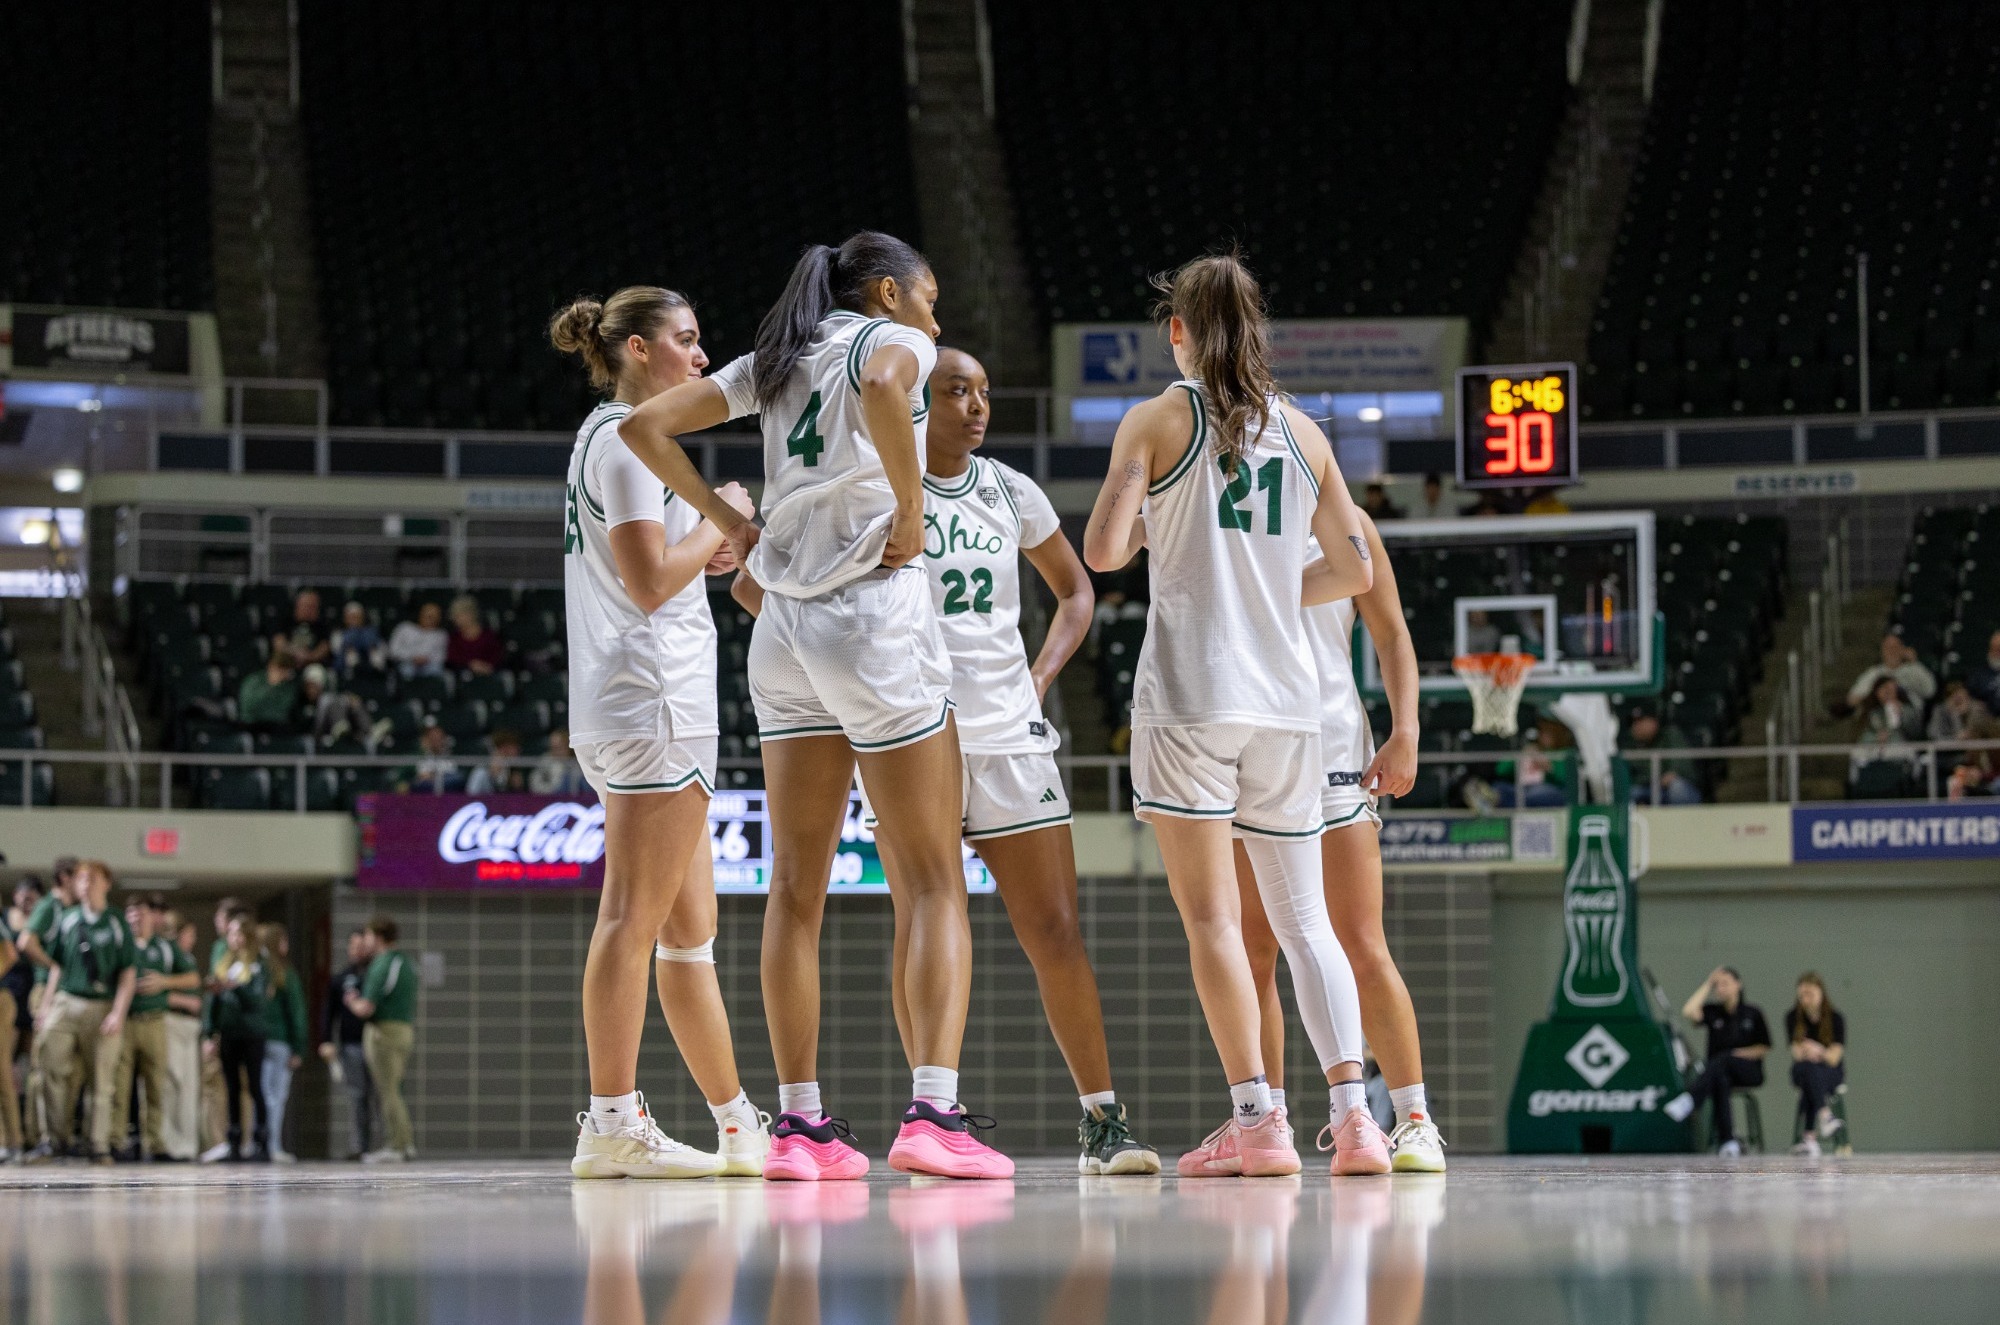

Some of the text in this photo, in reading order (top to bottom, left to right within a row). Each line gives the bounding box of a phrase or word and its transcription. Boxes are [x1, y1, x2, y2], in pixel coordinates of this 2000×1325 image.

[45, 314, 154, 352] ATHENS
[1491, 377, 1564, 414] 6:46
[787, 391, 824, 467] 4
[1485, 412, 1553, 473] 30
[1217, 450, 1284, 536] 21
[1735, 472, 1855, 490] RESERVED
[923, 512, 1003, 560] Ohio
[940, 567, 994, 616] 22
[1528, 1085, 1660, 1117] gomart
